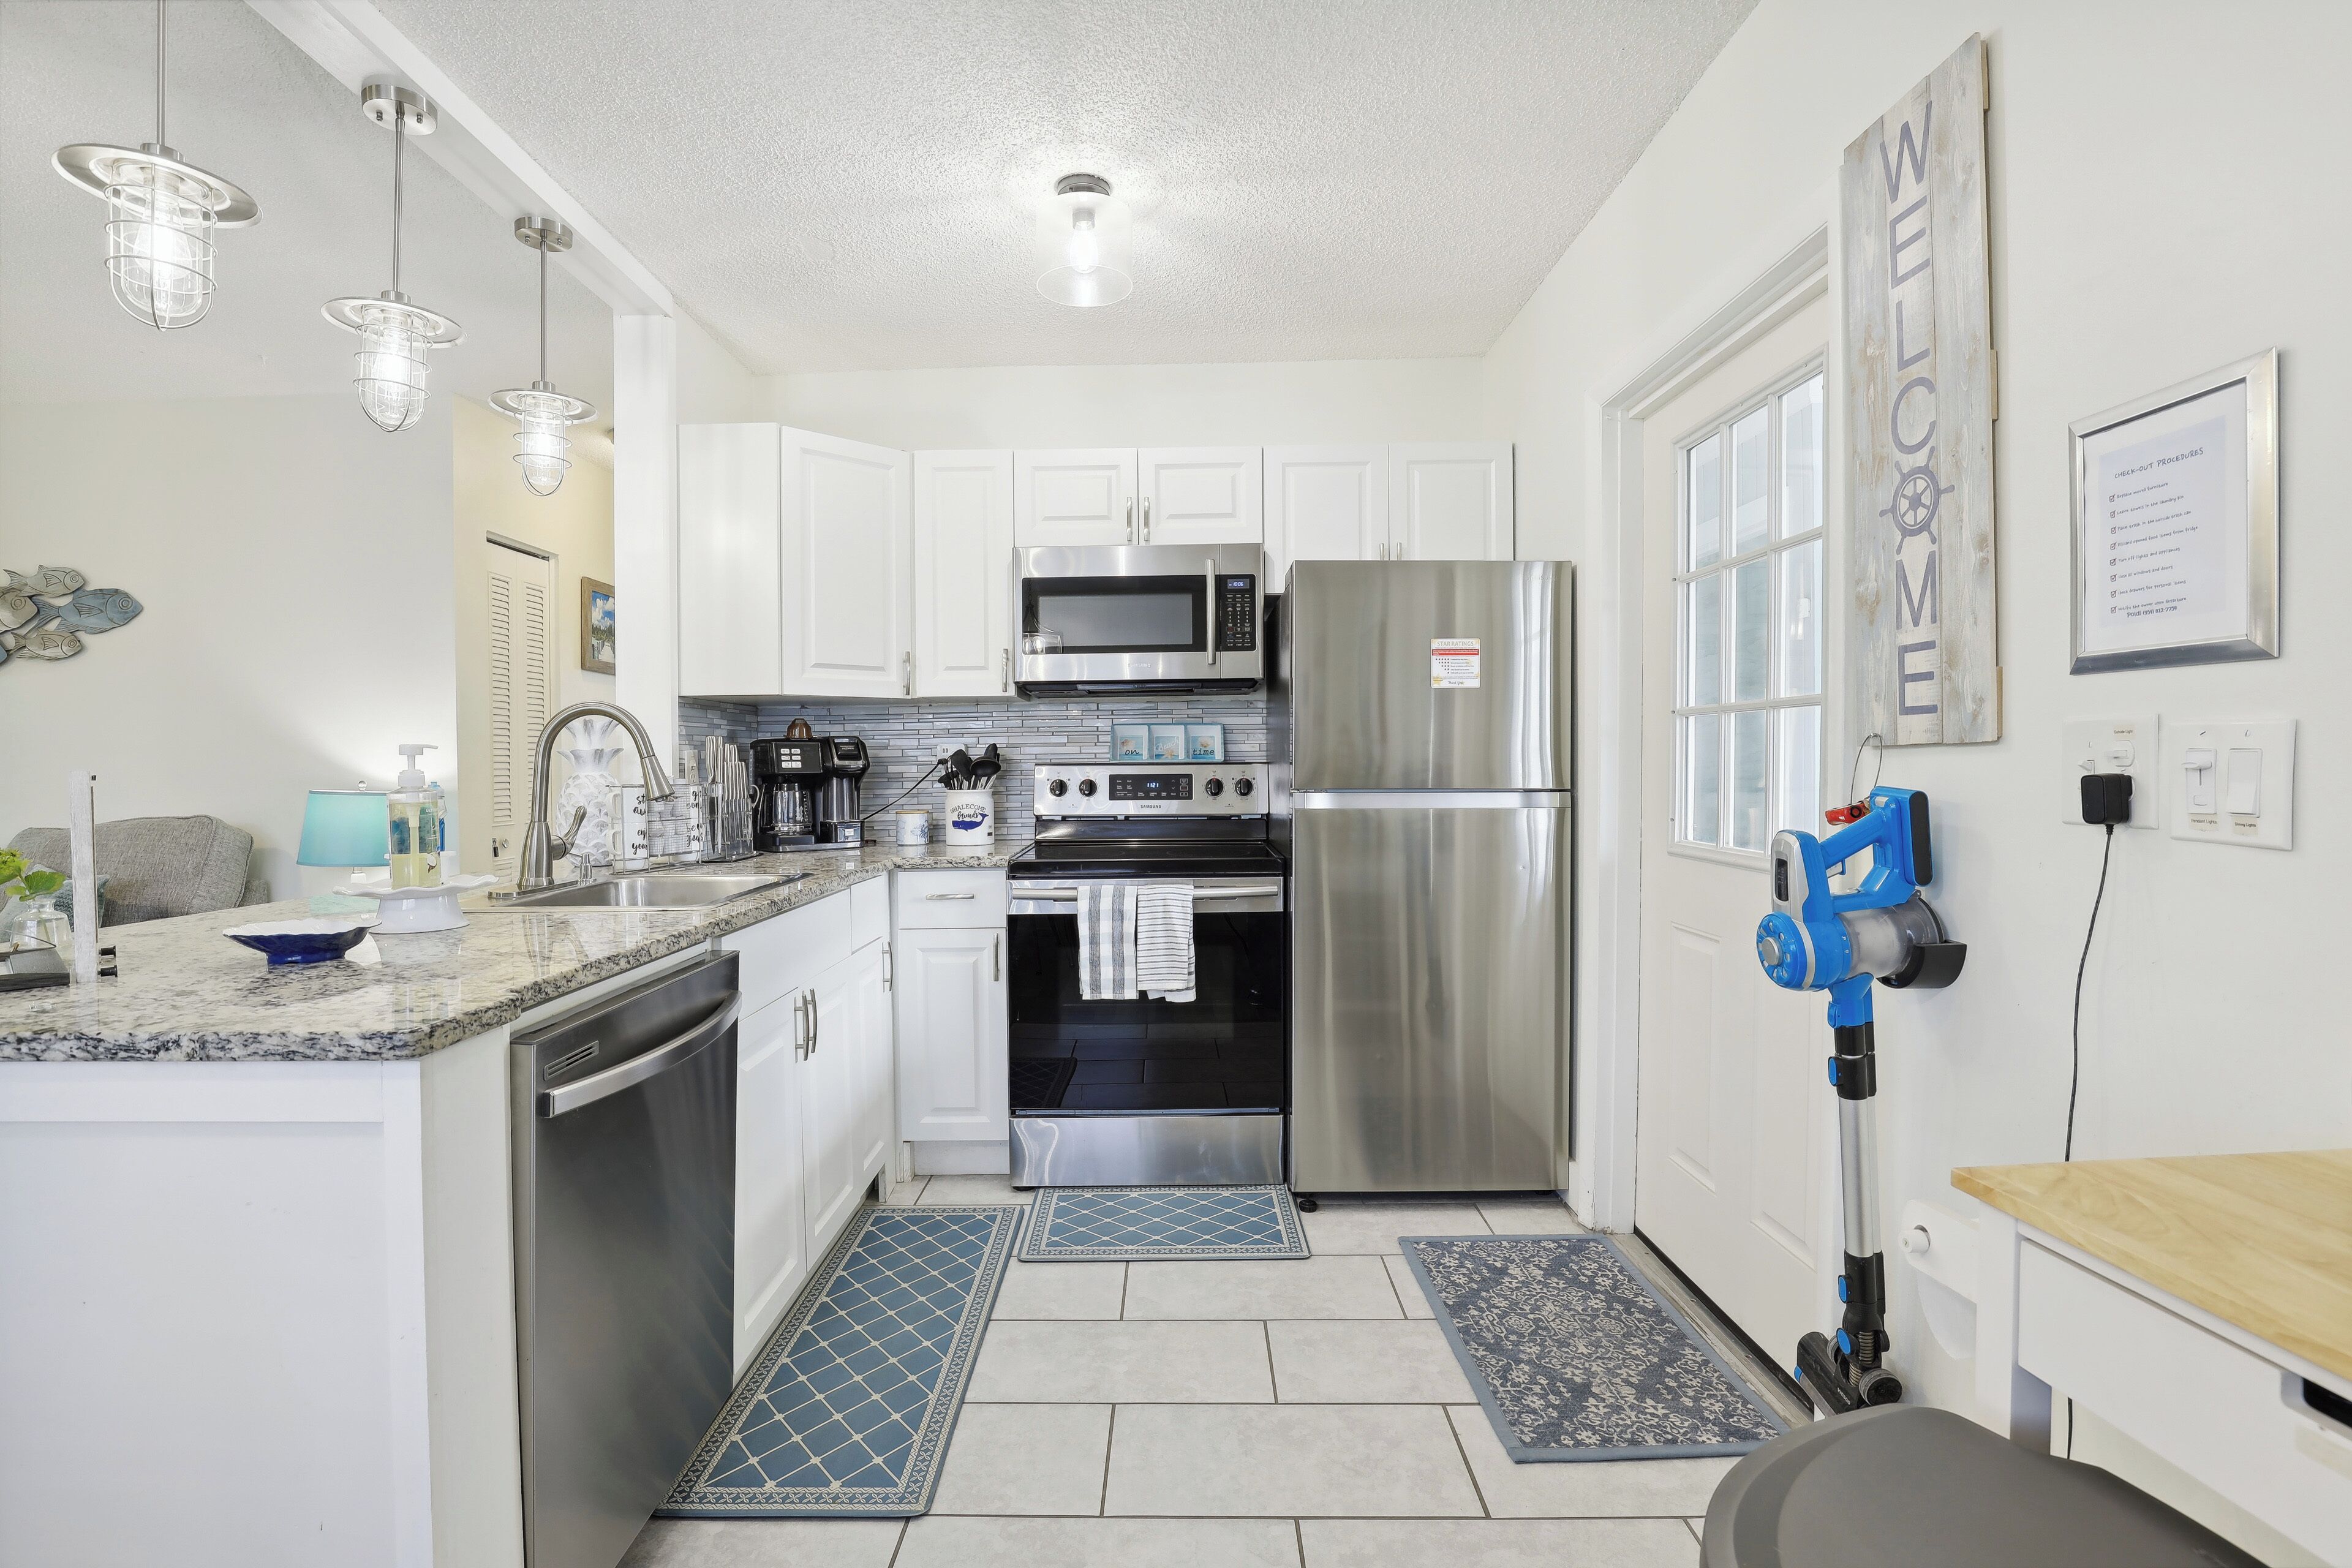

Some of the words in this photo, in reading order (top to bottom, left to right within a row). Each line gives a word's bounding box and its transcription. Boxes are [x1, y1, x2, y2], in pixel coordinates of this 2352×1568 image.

[1879, 100, 1943, 717] WELCOME
[2114, 462, 2154, 478] CHECK-OUT
[2157, 447, 2204, 467] PROCEDURES
[2158, 547, 2180, 556] appliances
[1155, 736, 1180, 752] Beach
[950, 804, 986, 814] WHALECOME
[957, 810, 978, 820] friends
